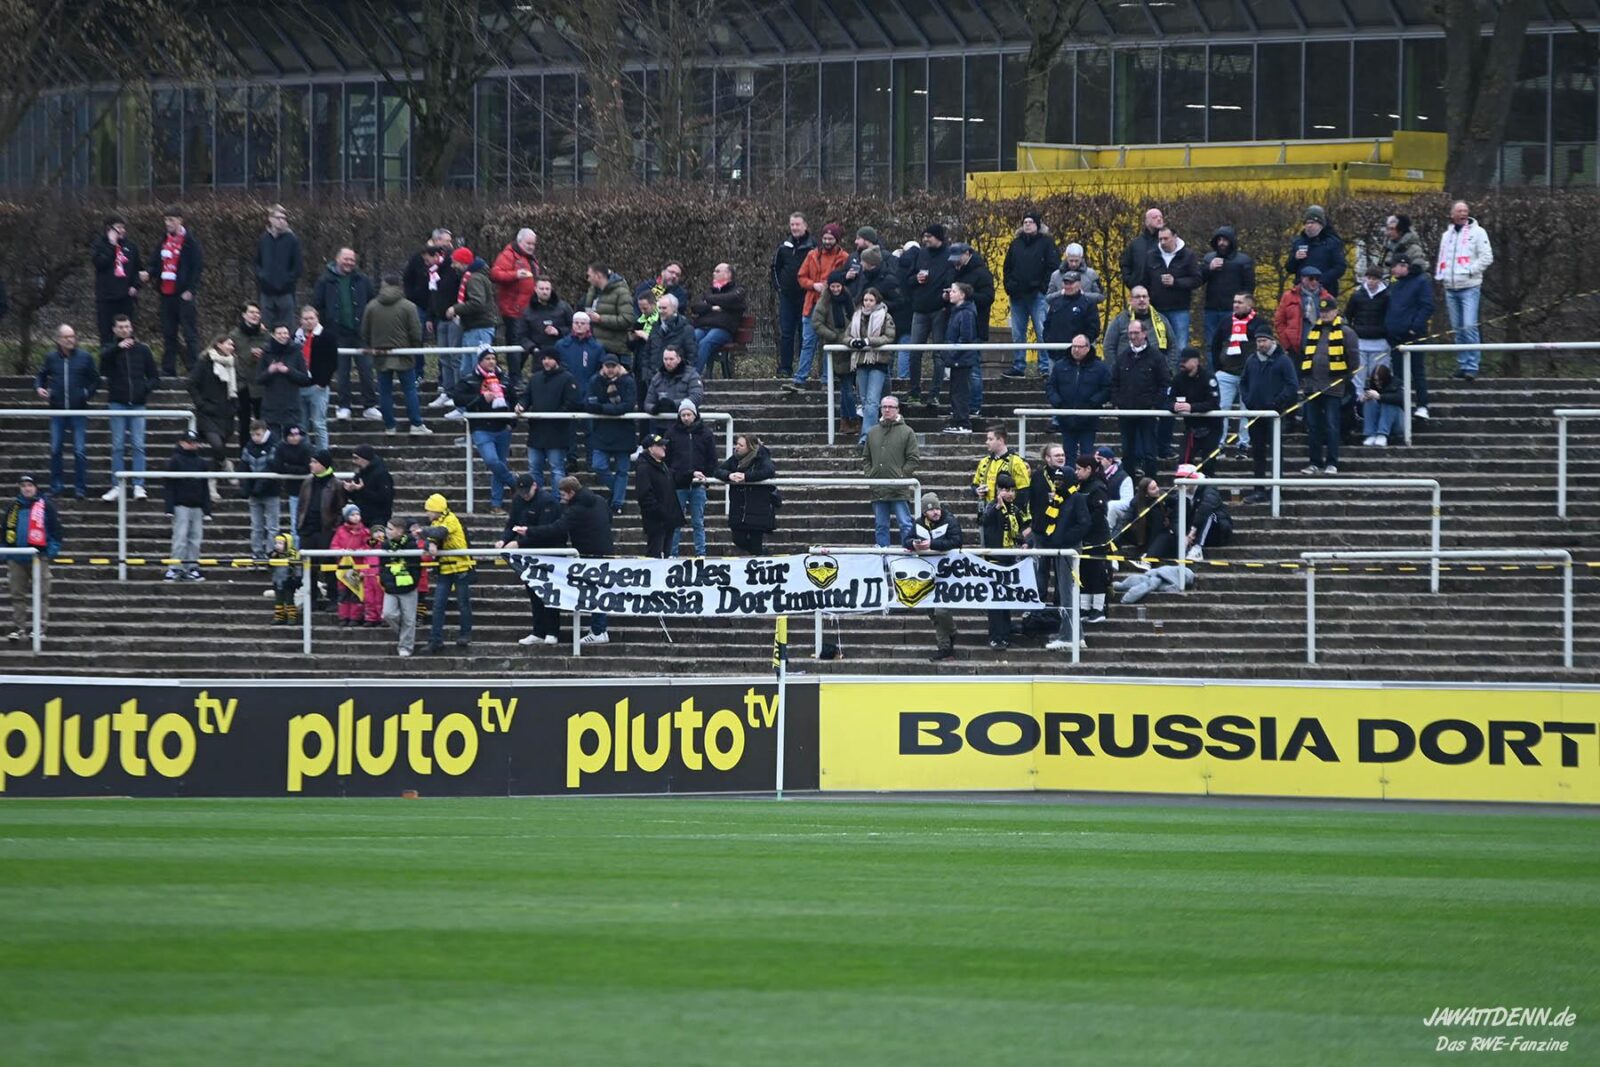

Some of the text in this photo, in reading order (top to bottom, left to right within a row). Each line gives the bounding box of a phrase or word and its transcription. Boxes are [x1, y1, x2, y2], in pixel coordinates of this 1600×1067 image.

[567, 563, 652, 589] geben
[665, 559, 731, 588] alles
[744, 560, 790, 585] für
[574, 584, 704, 614] Borussia
[714, 578, 859, 614] Dortmund
[933, 581, 989, 603] Rote
[0, 691, 239, 791] pluto tv
[286, 690, 518, 791] pluto tv
[566, 687, 780, 788] pluto tv
[899, 710, 1600, 769] BORUSSIA DORT
